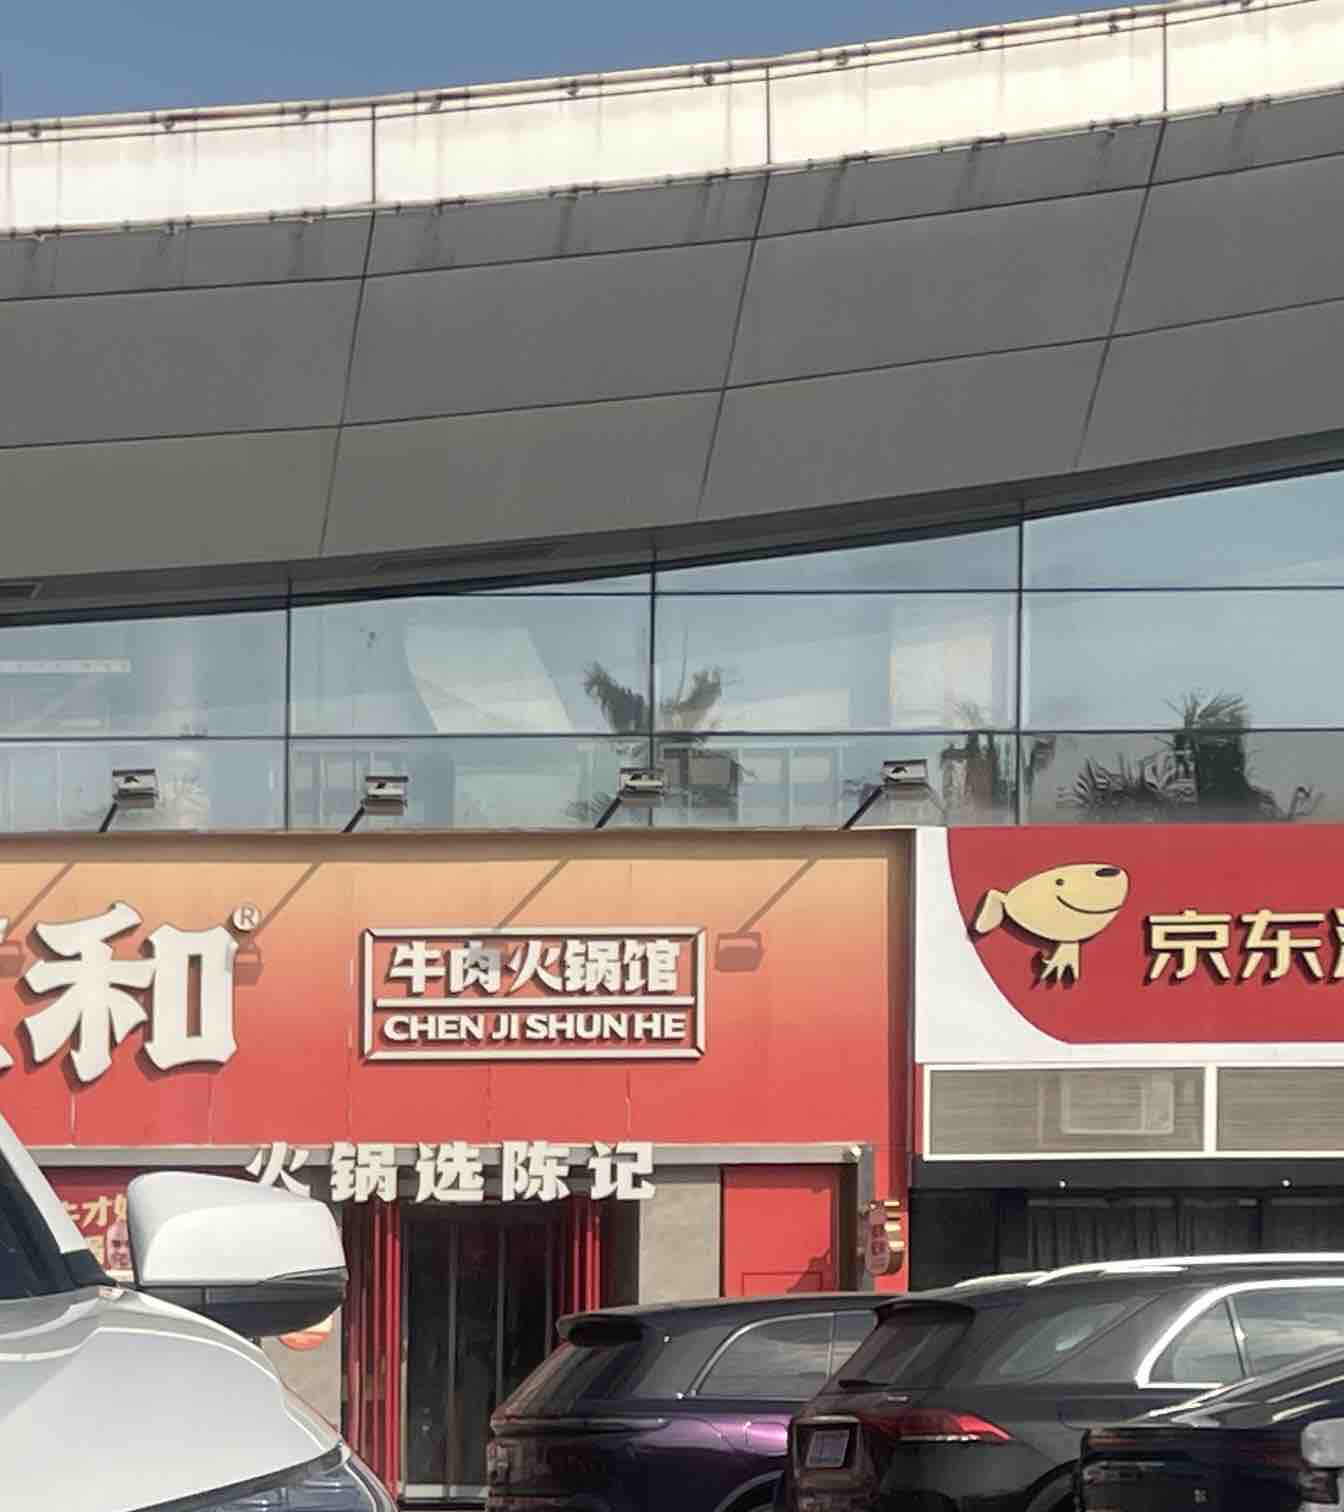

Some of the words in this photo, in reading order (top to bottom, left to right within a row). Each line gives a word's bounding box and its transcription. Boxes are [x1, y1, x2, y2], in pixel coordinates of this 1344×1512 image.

[388, 939, 681, 994] 牛肉火锅馆
[1150, 909, 1344, 980] 京东
[383, 1013, 484, 1042] CHEN
[491, 1013, 519, 1042] JI
[525, 1013, 629, 1041] SHUN
[634, 1012, 686, 1040] HE
[246, 1141, 657, 1203] 火锅选陈记
